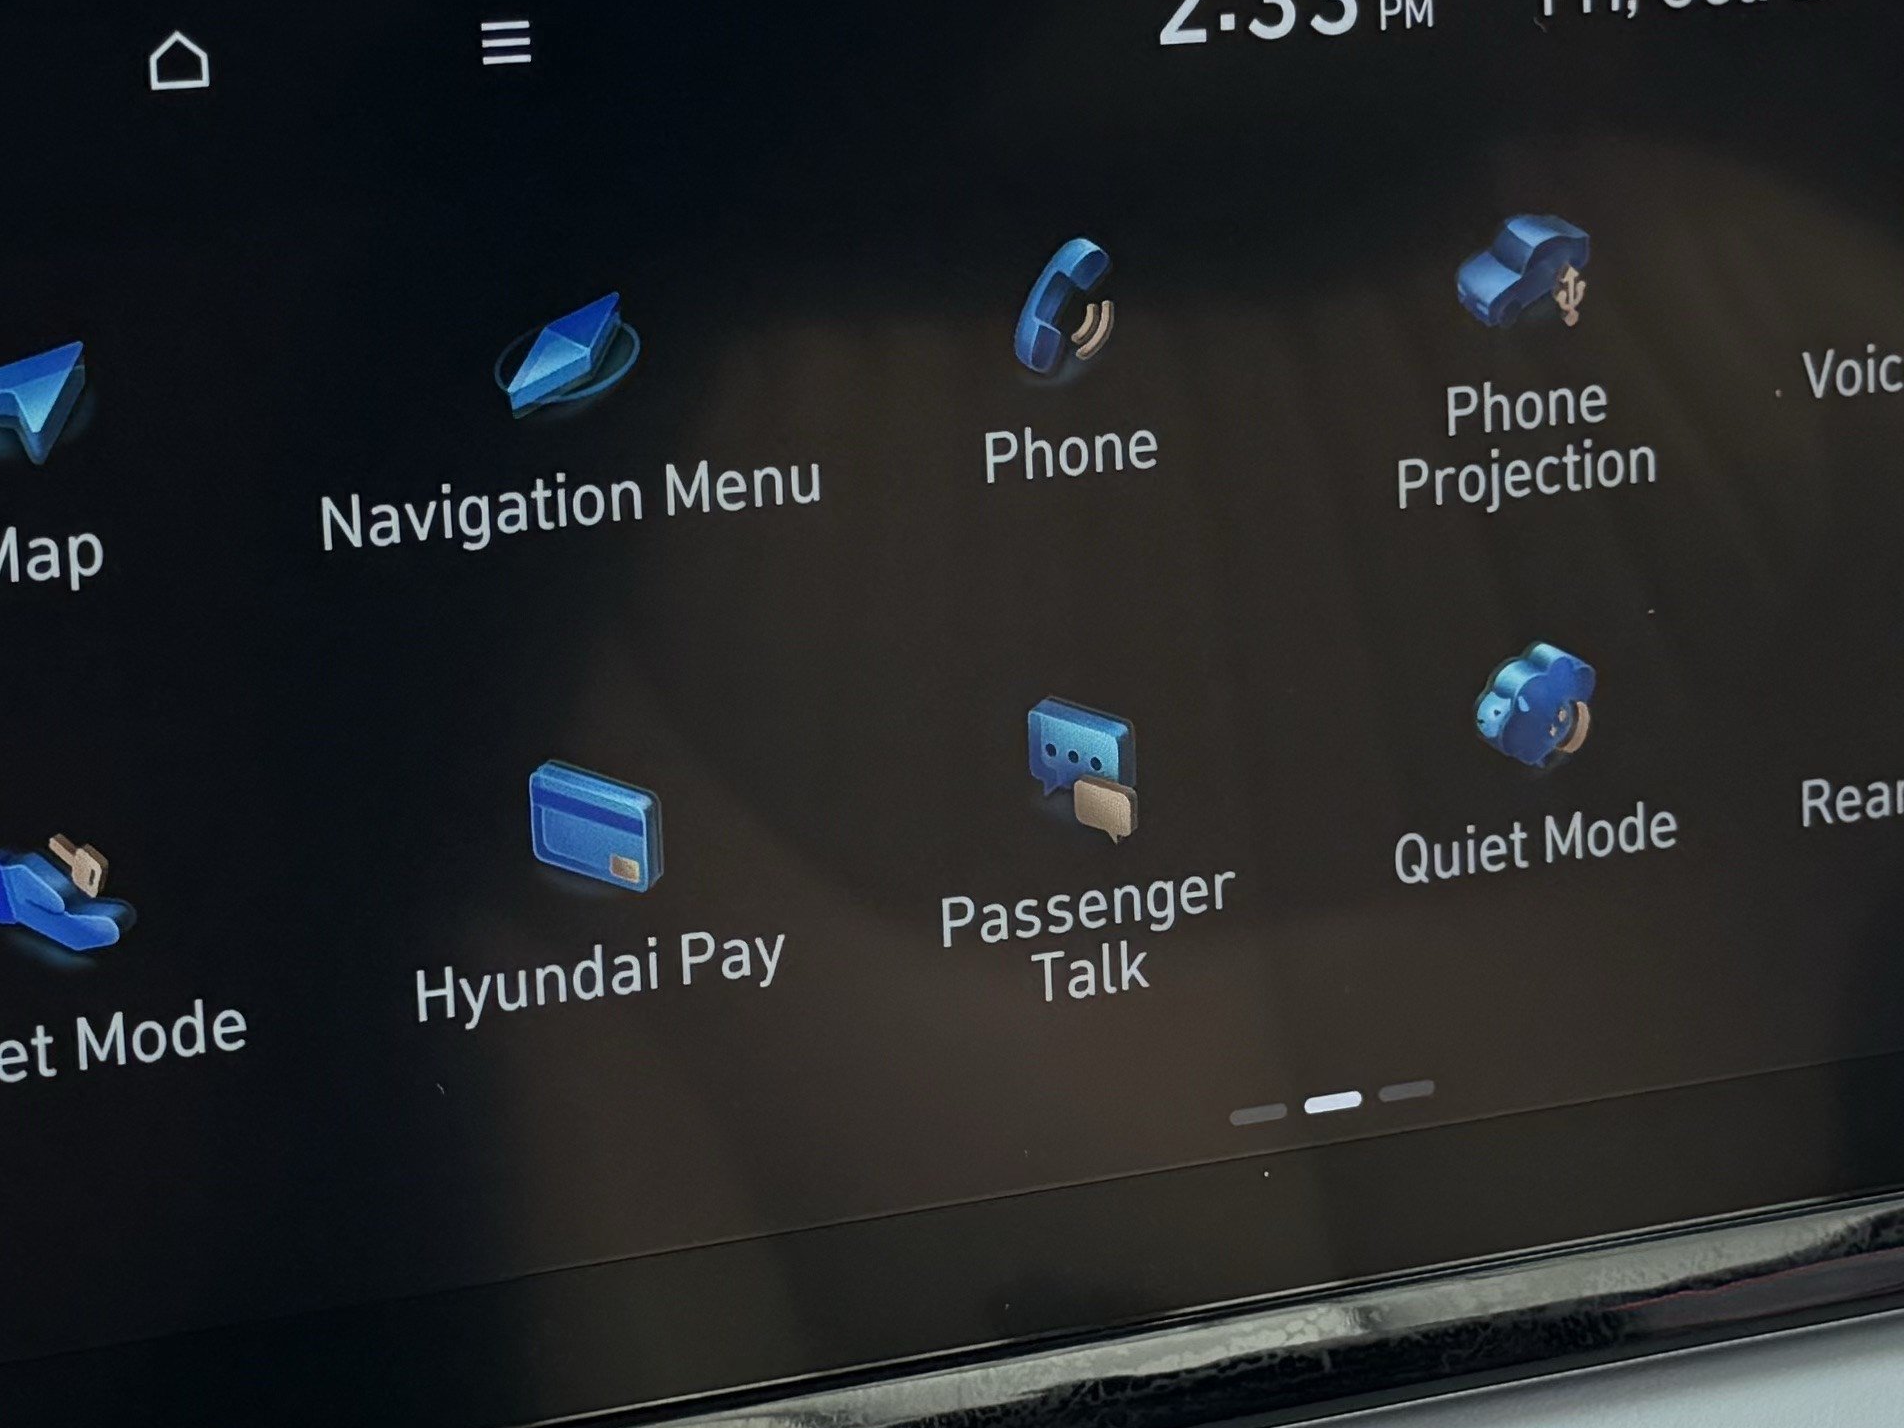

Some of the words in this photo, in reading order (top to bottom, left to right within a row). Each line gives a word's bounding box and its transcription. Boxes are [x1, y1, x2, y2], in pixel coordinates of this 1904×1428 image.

[1447, 381, 1608, 437] Phone
[985, 426, 1158, 484] Phone
[1398, 438, 1656, 513] Projection
[321, 472, 643, 551] Navigation
[665, 459, 821, 516] Menu
[1394, 821, 1529, 884] Quiet
[1544, 801, 1678, 864] Mode
[941, 870, 1237, 948] Passenger
[416, 936, 659, 1031] Hyundai
[680, 931, 786, 988] Pay
[1030, 939, 1151, 1002] Talk
[76, 998, 247, 1071] Mode
